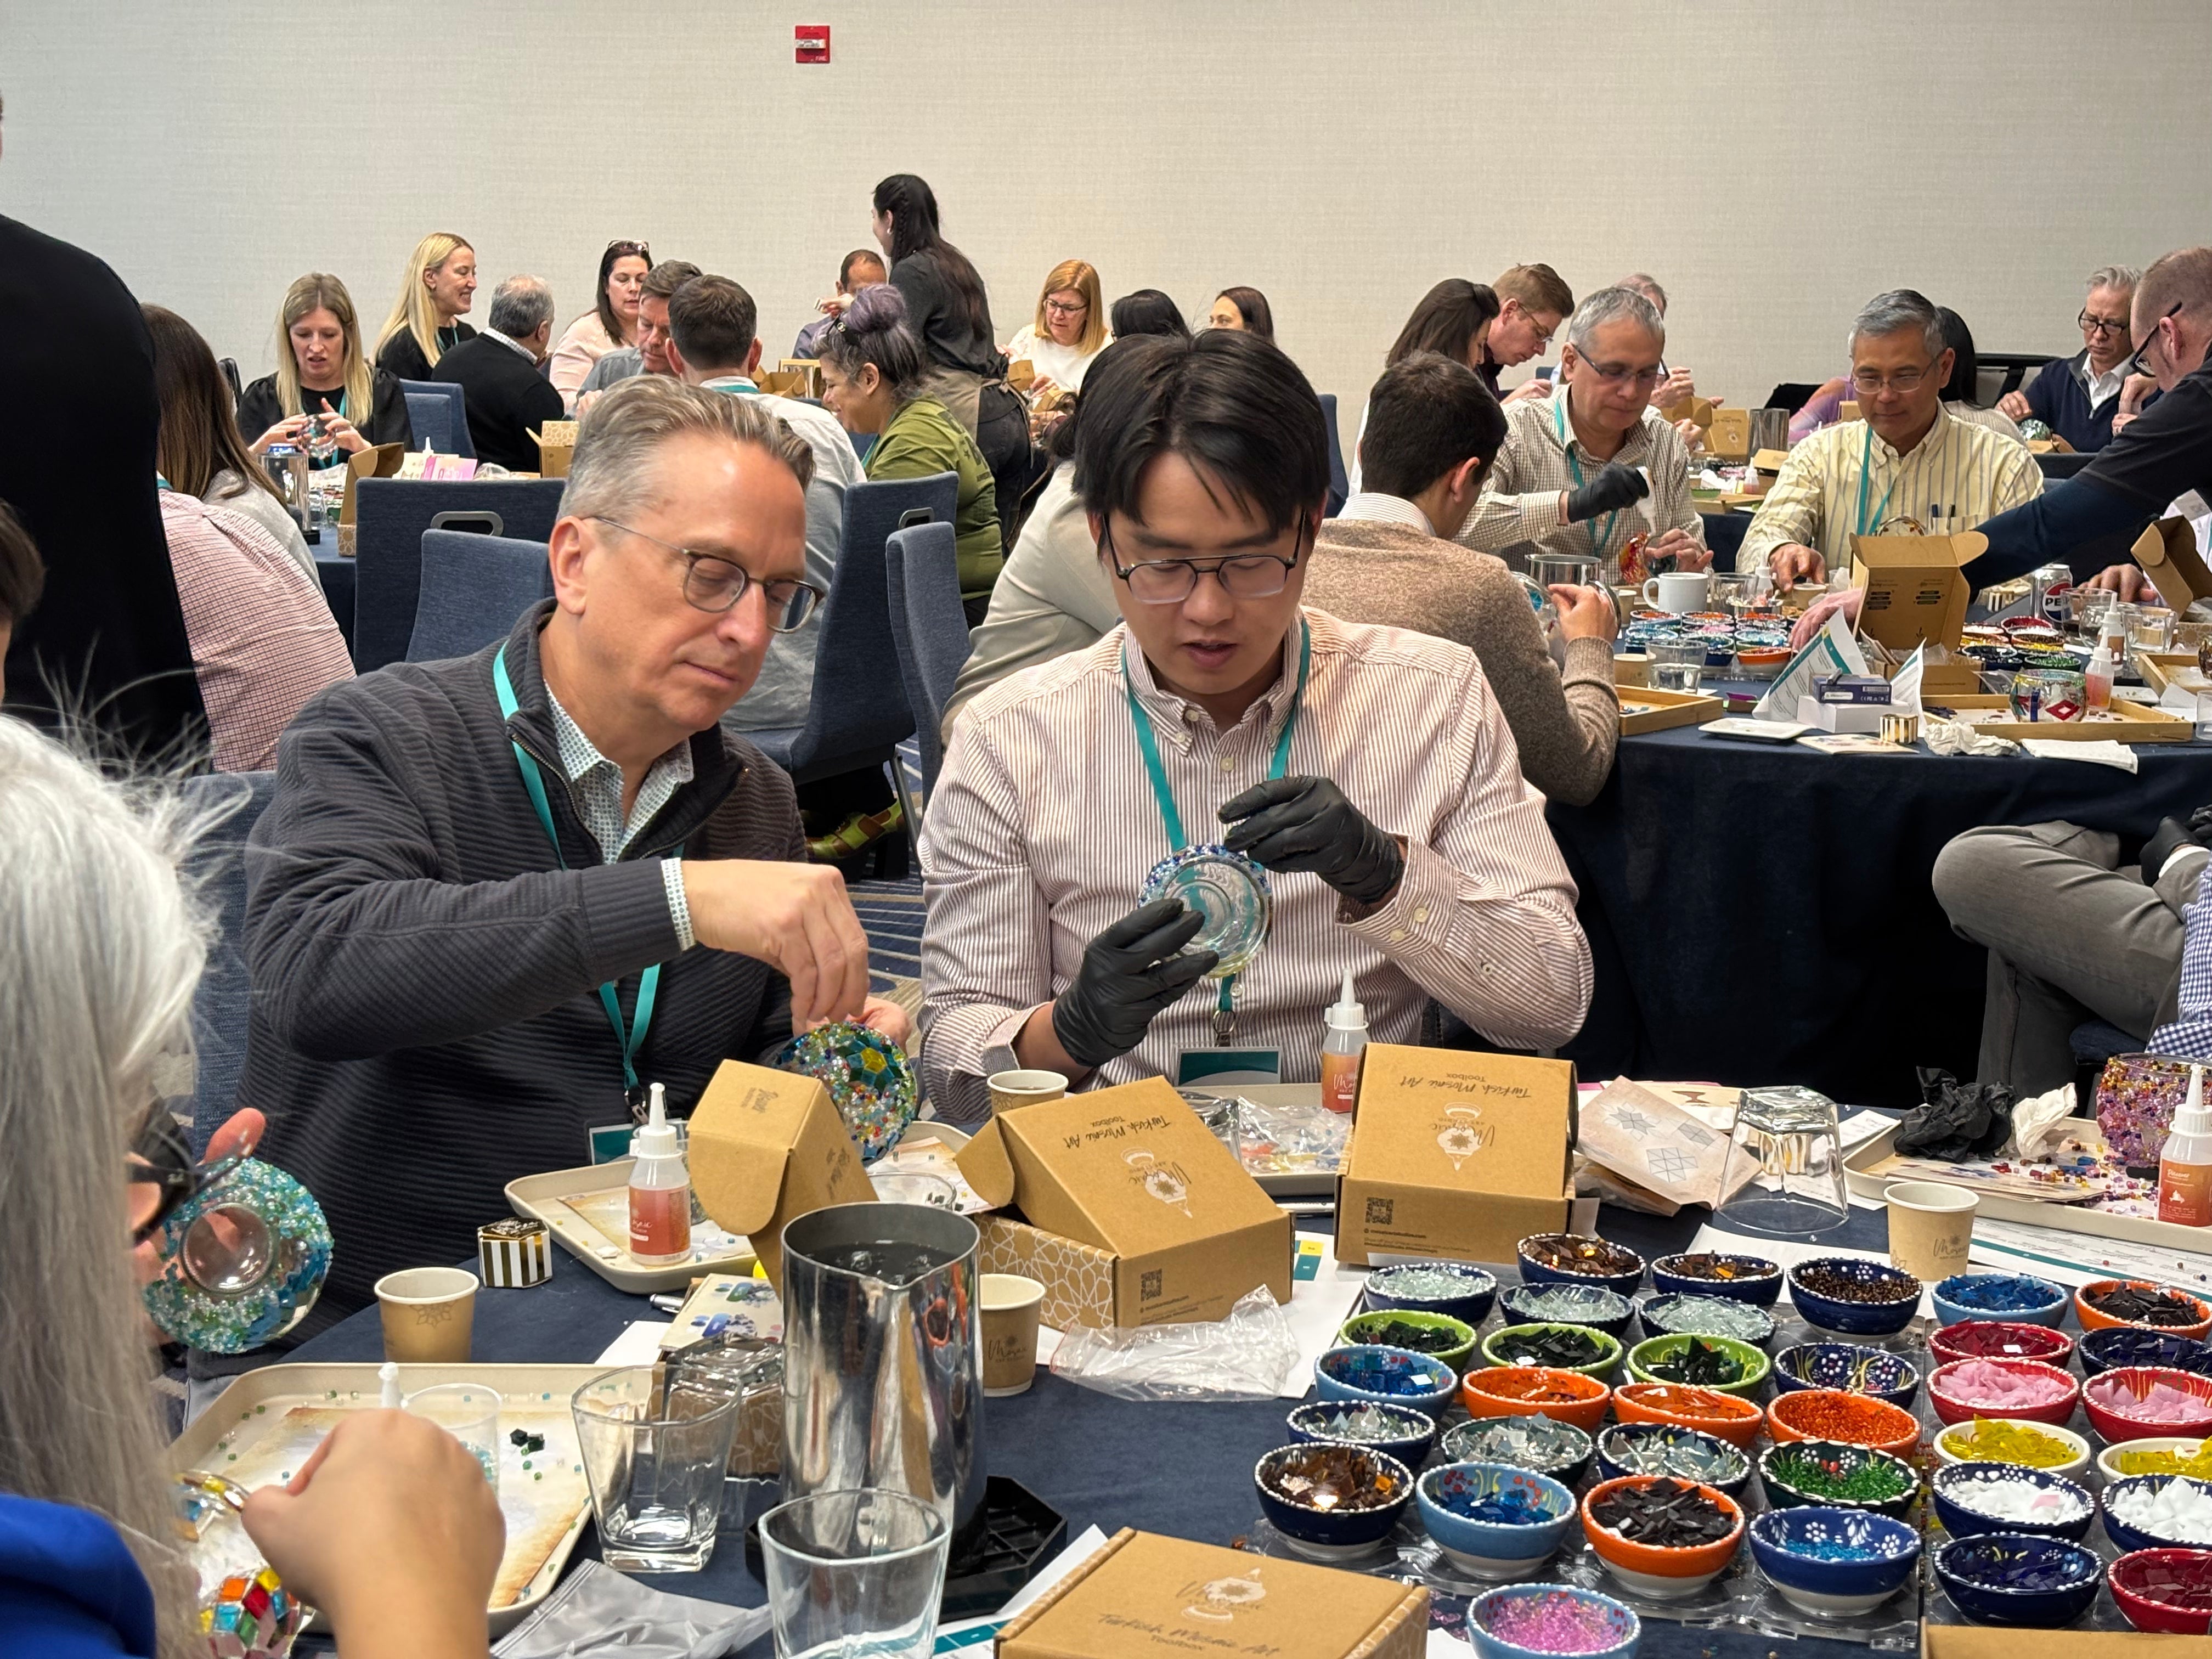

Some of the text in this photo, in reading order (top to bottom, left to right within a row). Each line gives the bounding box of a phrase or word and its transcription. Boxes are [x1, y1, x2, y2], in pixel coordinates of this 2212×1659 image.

[1446, 1073, 1486, 1082] Toolbox
[1400, 1075, 1531, 1099] Turkish Mosaic Art
[1063, 1134, 1080, 1149] Art
